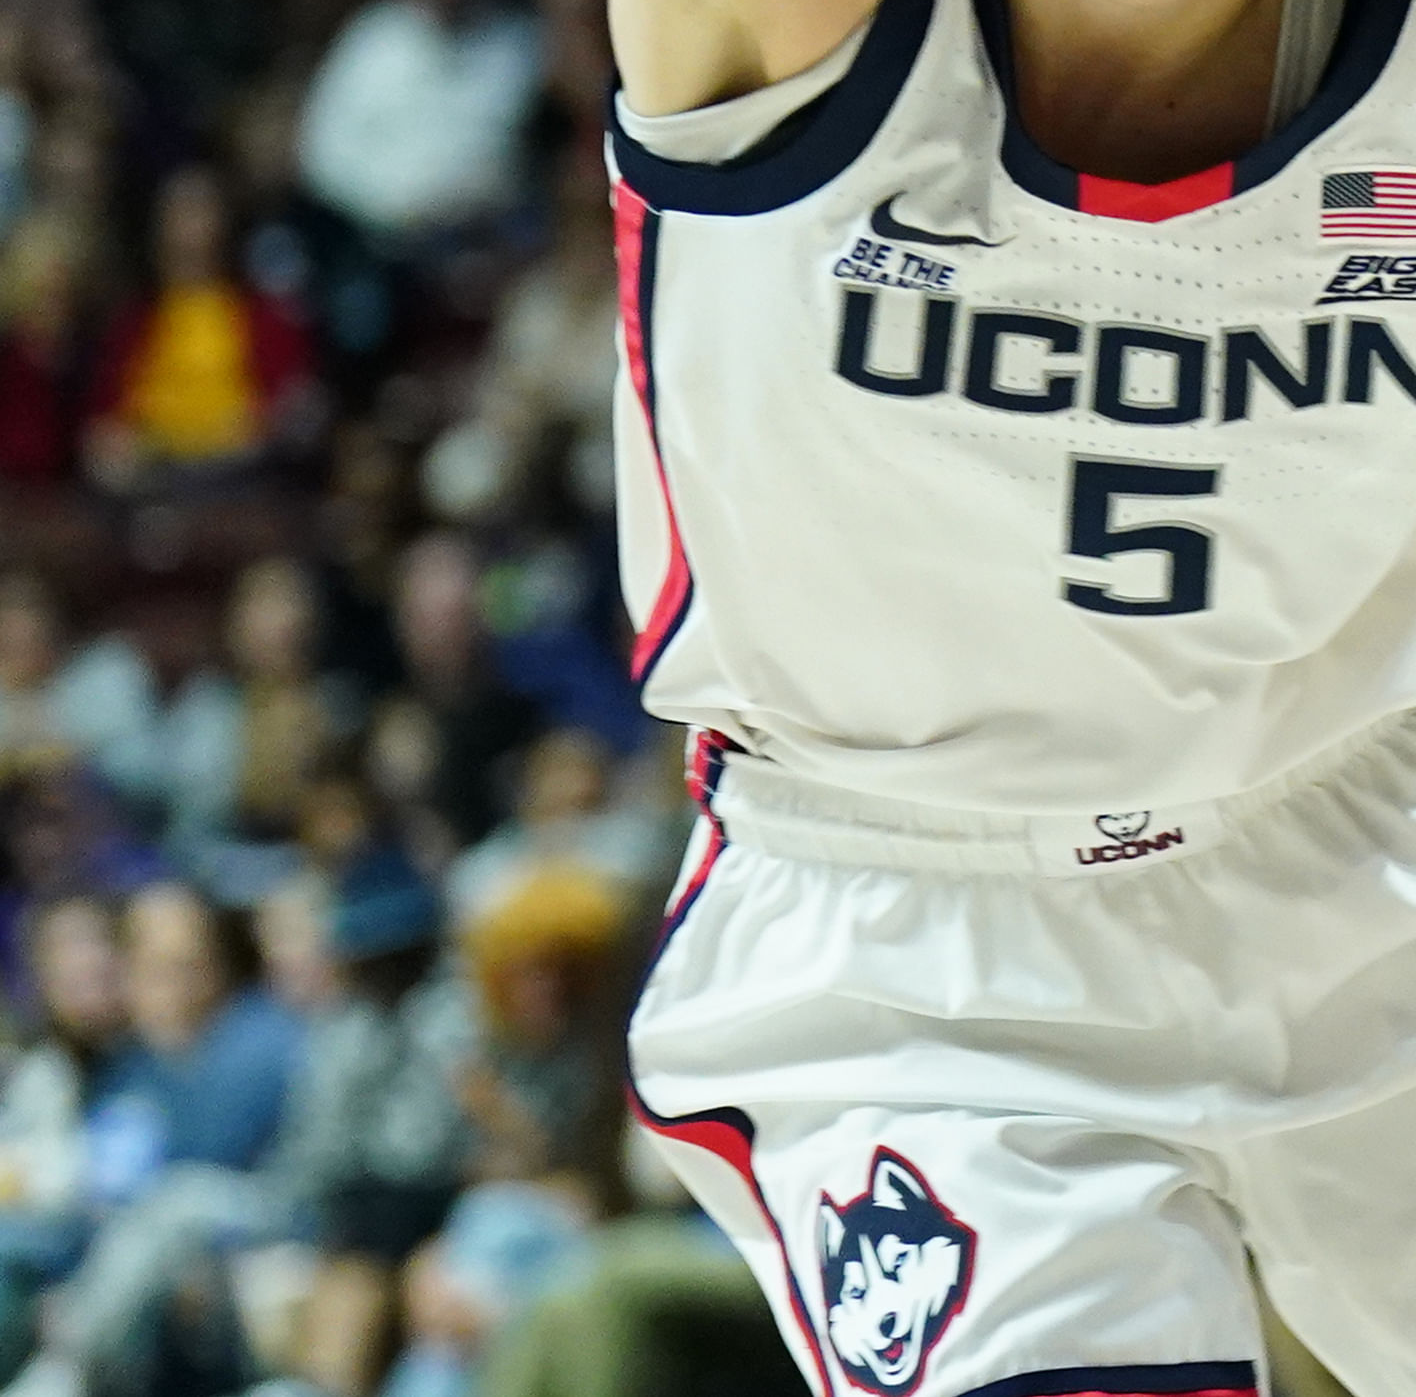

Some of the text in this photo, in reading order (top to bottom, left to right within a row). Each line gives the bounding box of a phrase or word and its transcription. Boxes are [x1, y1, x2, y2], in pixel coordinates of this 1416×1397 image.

[851, 237, 956, 286] BE THE
[1061, 452, 1223, 616] 5
[1074, 826, 1184, 865] UCONN
